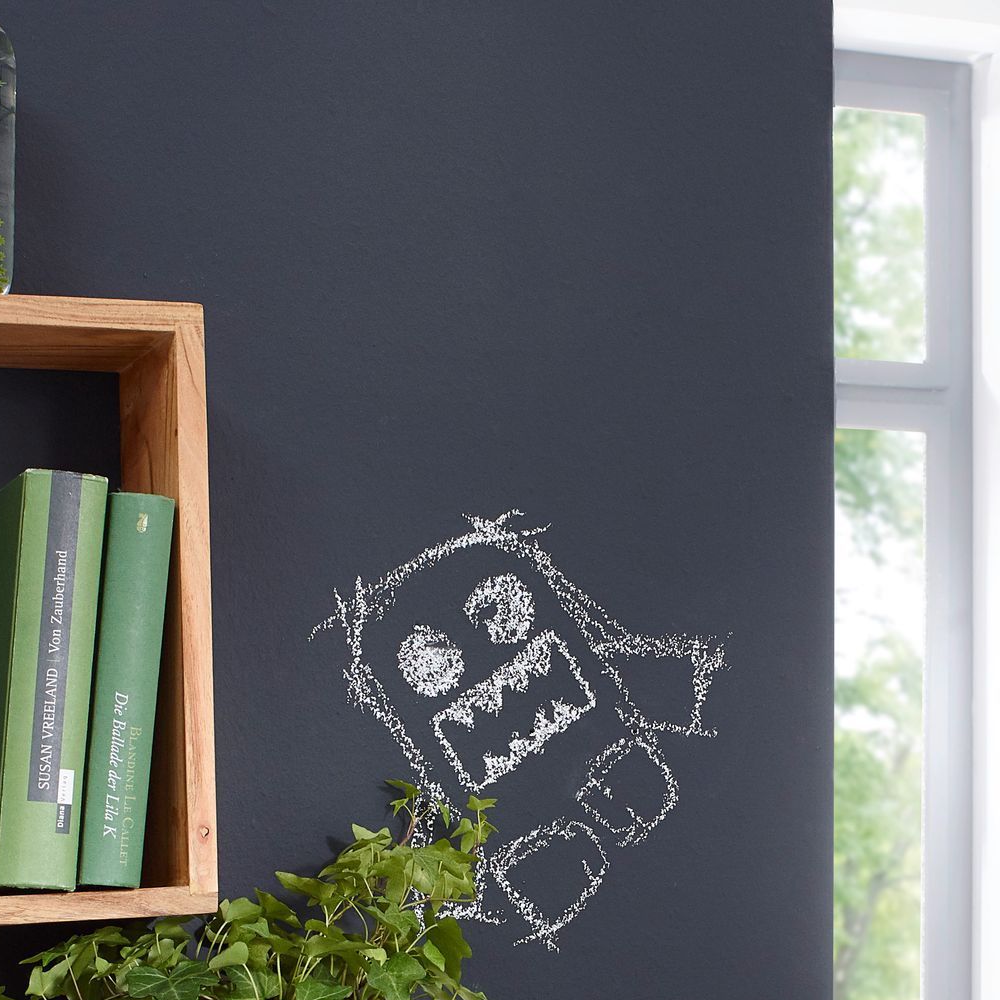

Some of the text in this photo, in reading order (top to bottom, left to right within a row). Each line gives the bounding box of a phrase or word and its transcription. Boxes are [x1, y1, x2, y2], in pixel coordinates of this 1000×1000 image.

[38, 550, 68, 790] SUSAN VREELAND Von Zauberhand
[57, 805, 65, 828] Diana
[103, 691, 129, 839] Die Ballade der Lila K
